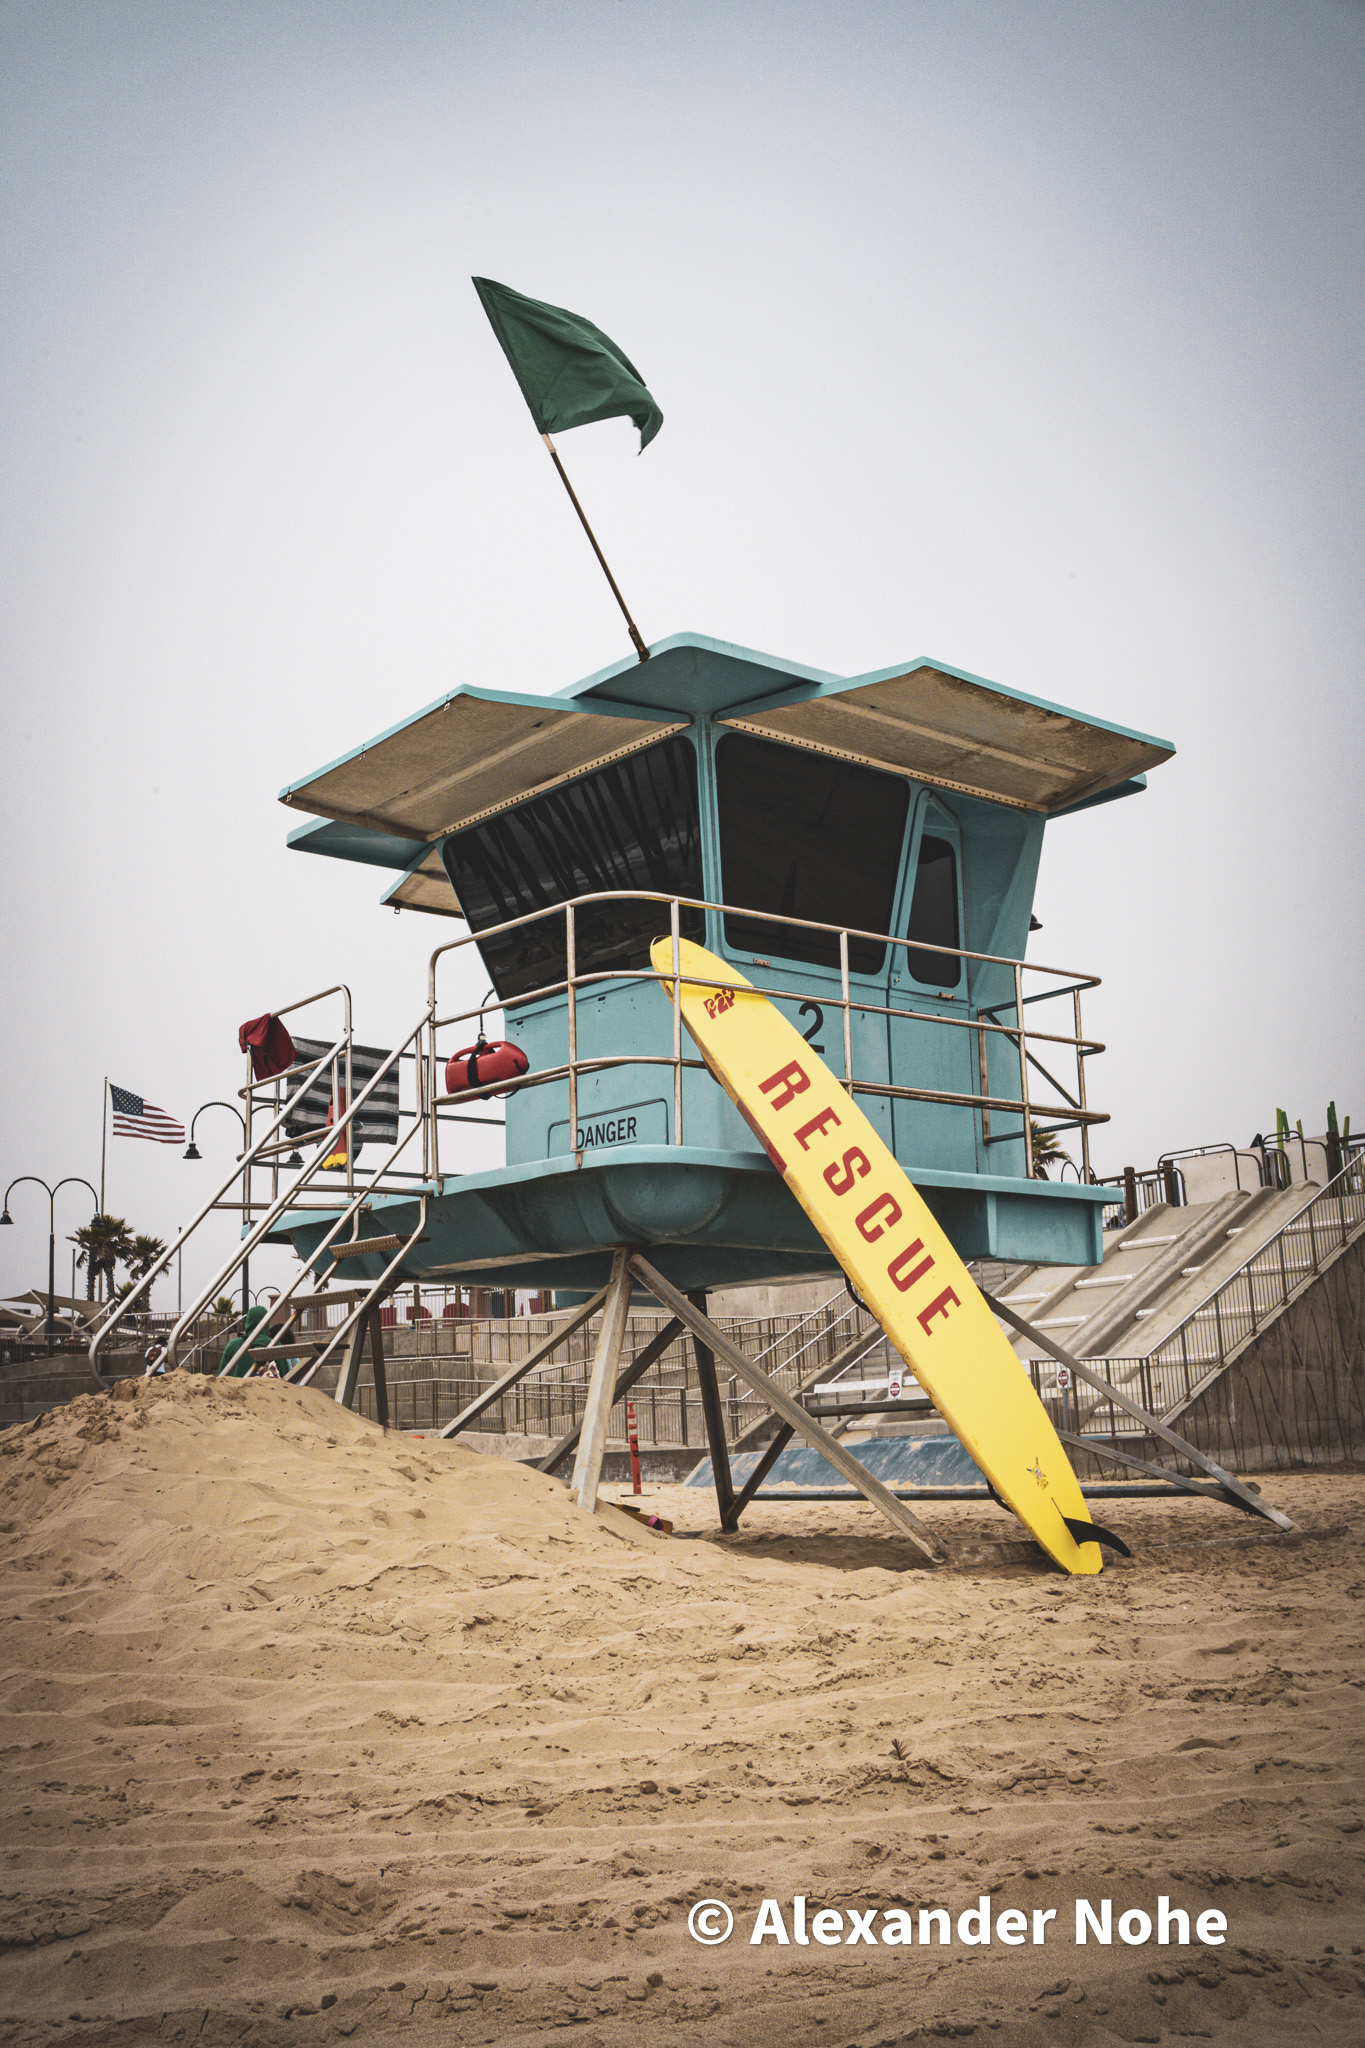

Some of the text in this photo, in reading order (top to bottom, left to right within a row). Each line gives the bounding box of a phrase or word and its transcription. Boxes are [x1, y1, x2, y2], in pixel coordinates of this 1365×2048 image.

[798, 1001, 825, 1054] 2
[577, 1116, 637, 1149] DANGER
[758, 1059, 962, 1337] RESCUE
